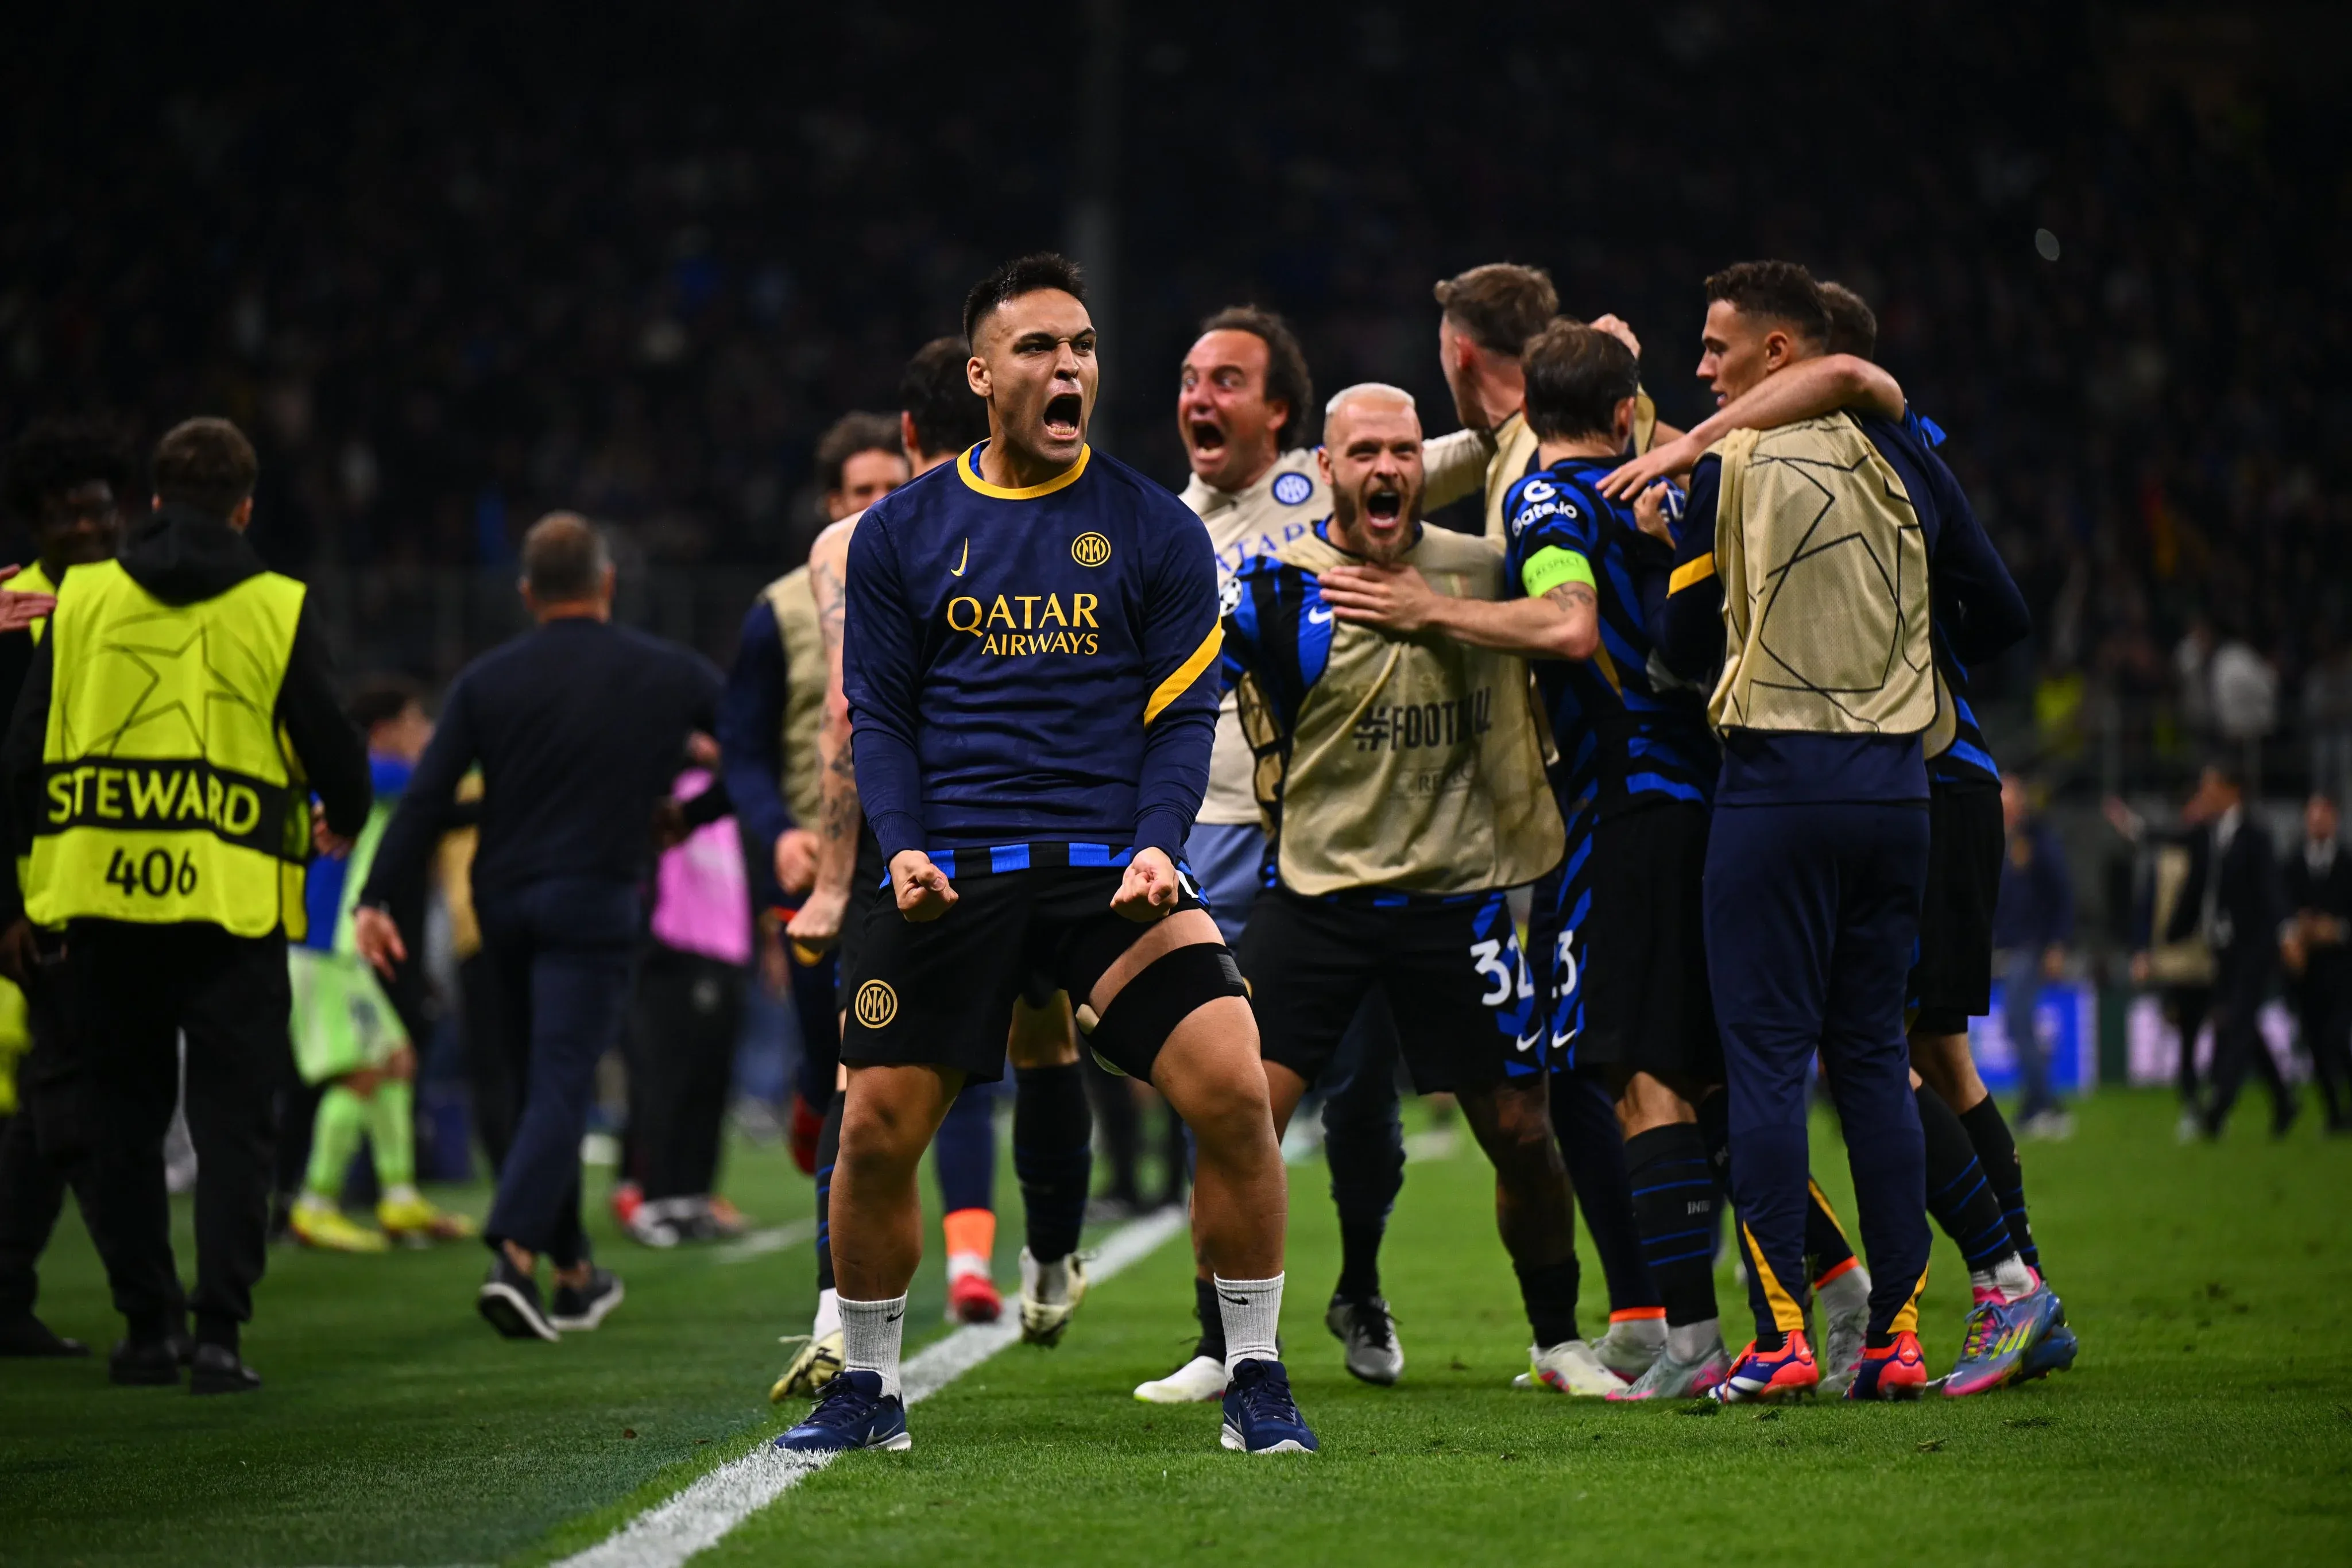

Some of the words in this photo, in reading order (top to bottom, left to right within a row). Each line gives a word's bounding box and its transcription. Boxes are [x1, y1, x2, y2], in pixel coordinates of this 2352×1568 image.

[1512, 501, 1578, 537] Gate.io
[947, 593, 1100, 637] QATAR
[981, 632, 1098, 656] AIRWAYS
[1353, 686, 1492, 752] #FOOTLL
[47, 766, 260, 835] STEWARD
[105, 847, 198, 898] 406
[1469, 933, 1535, 1005] 32
[1552, 929, 1577, 999] 3
